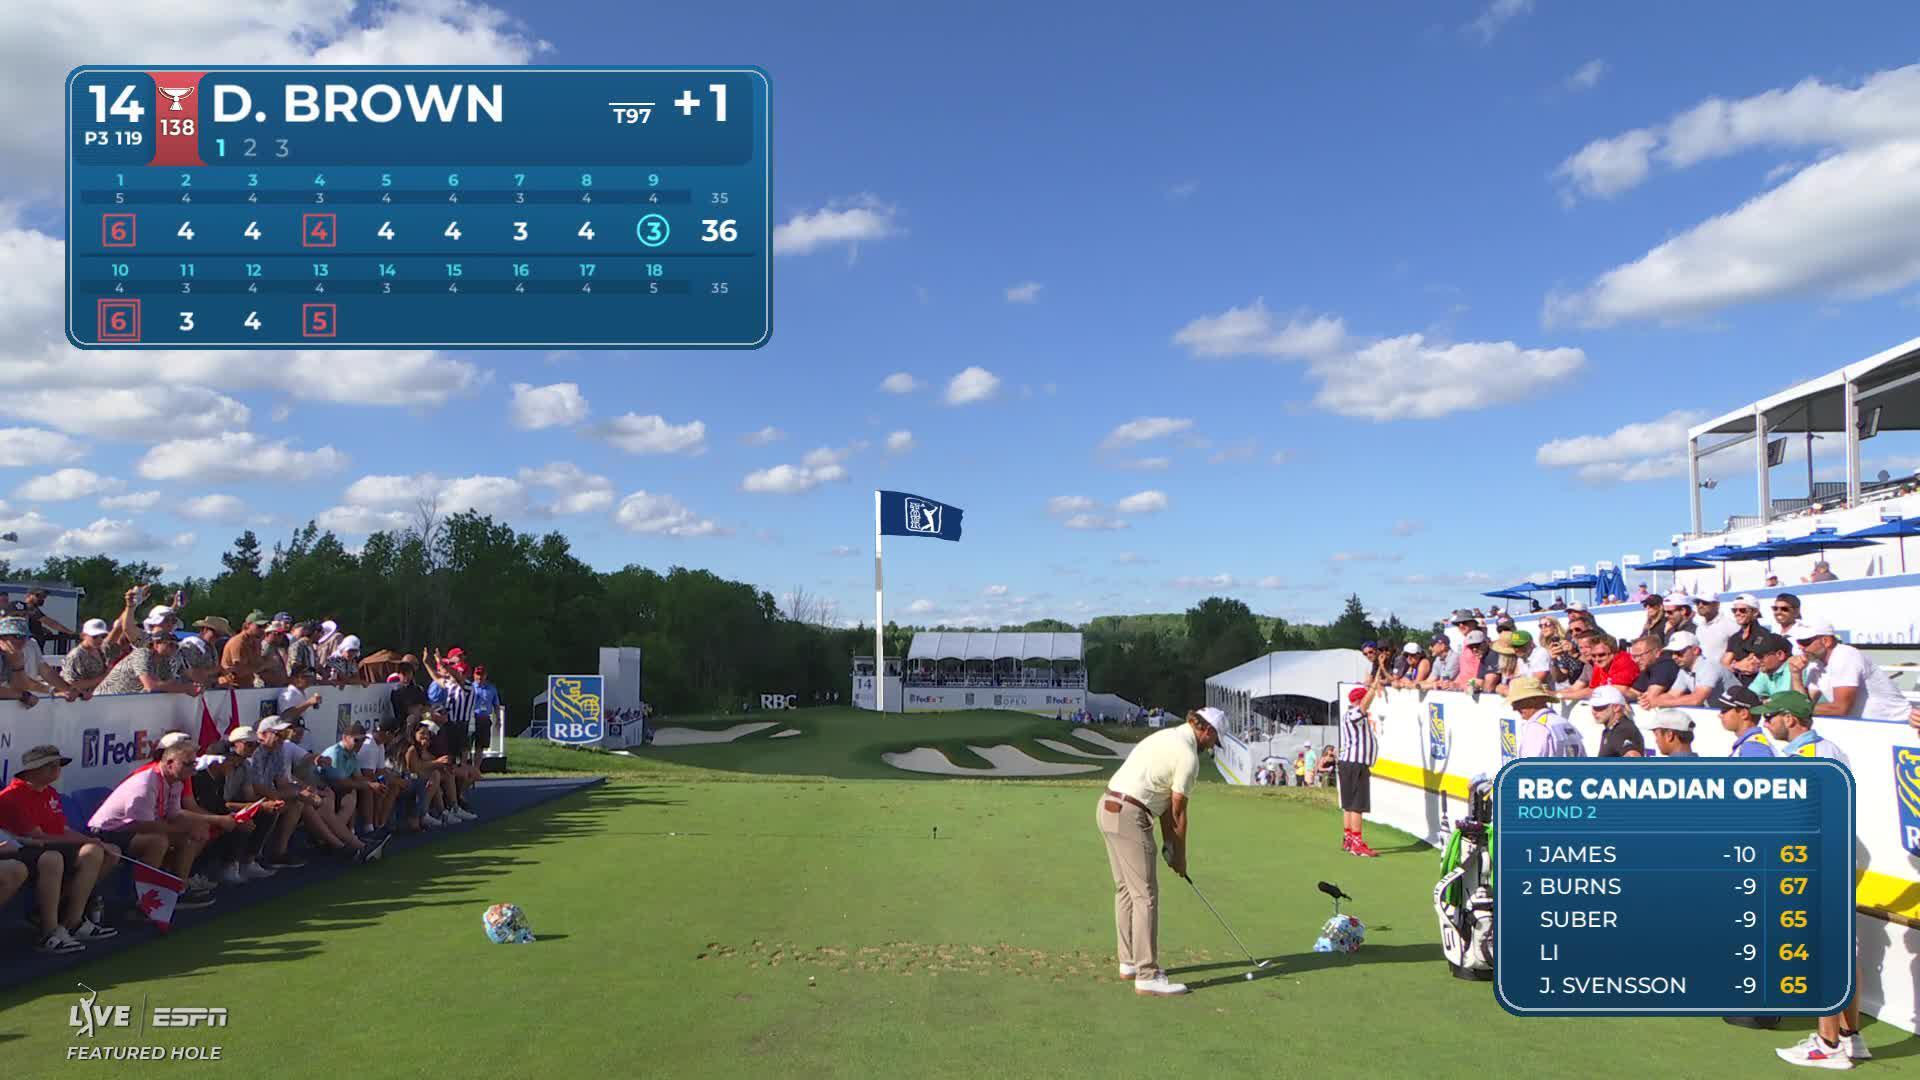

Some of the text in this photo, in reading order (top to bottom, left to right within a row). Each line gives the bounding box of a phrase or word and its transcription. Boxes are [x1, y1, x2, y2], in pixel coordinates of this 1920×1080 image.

[857, 678, 873, 690] 14
[760, 693, 798, 710] RBC
[554, 722, 599, 739] RBC
